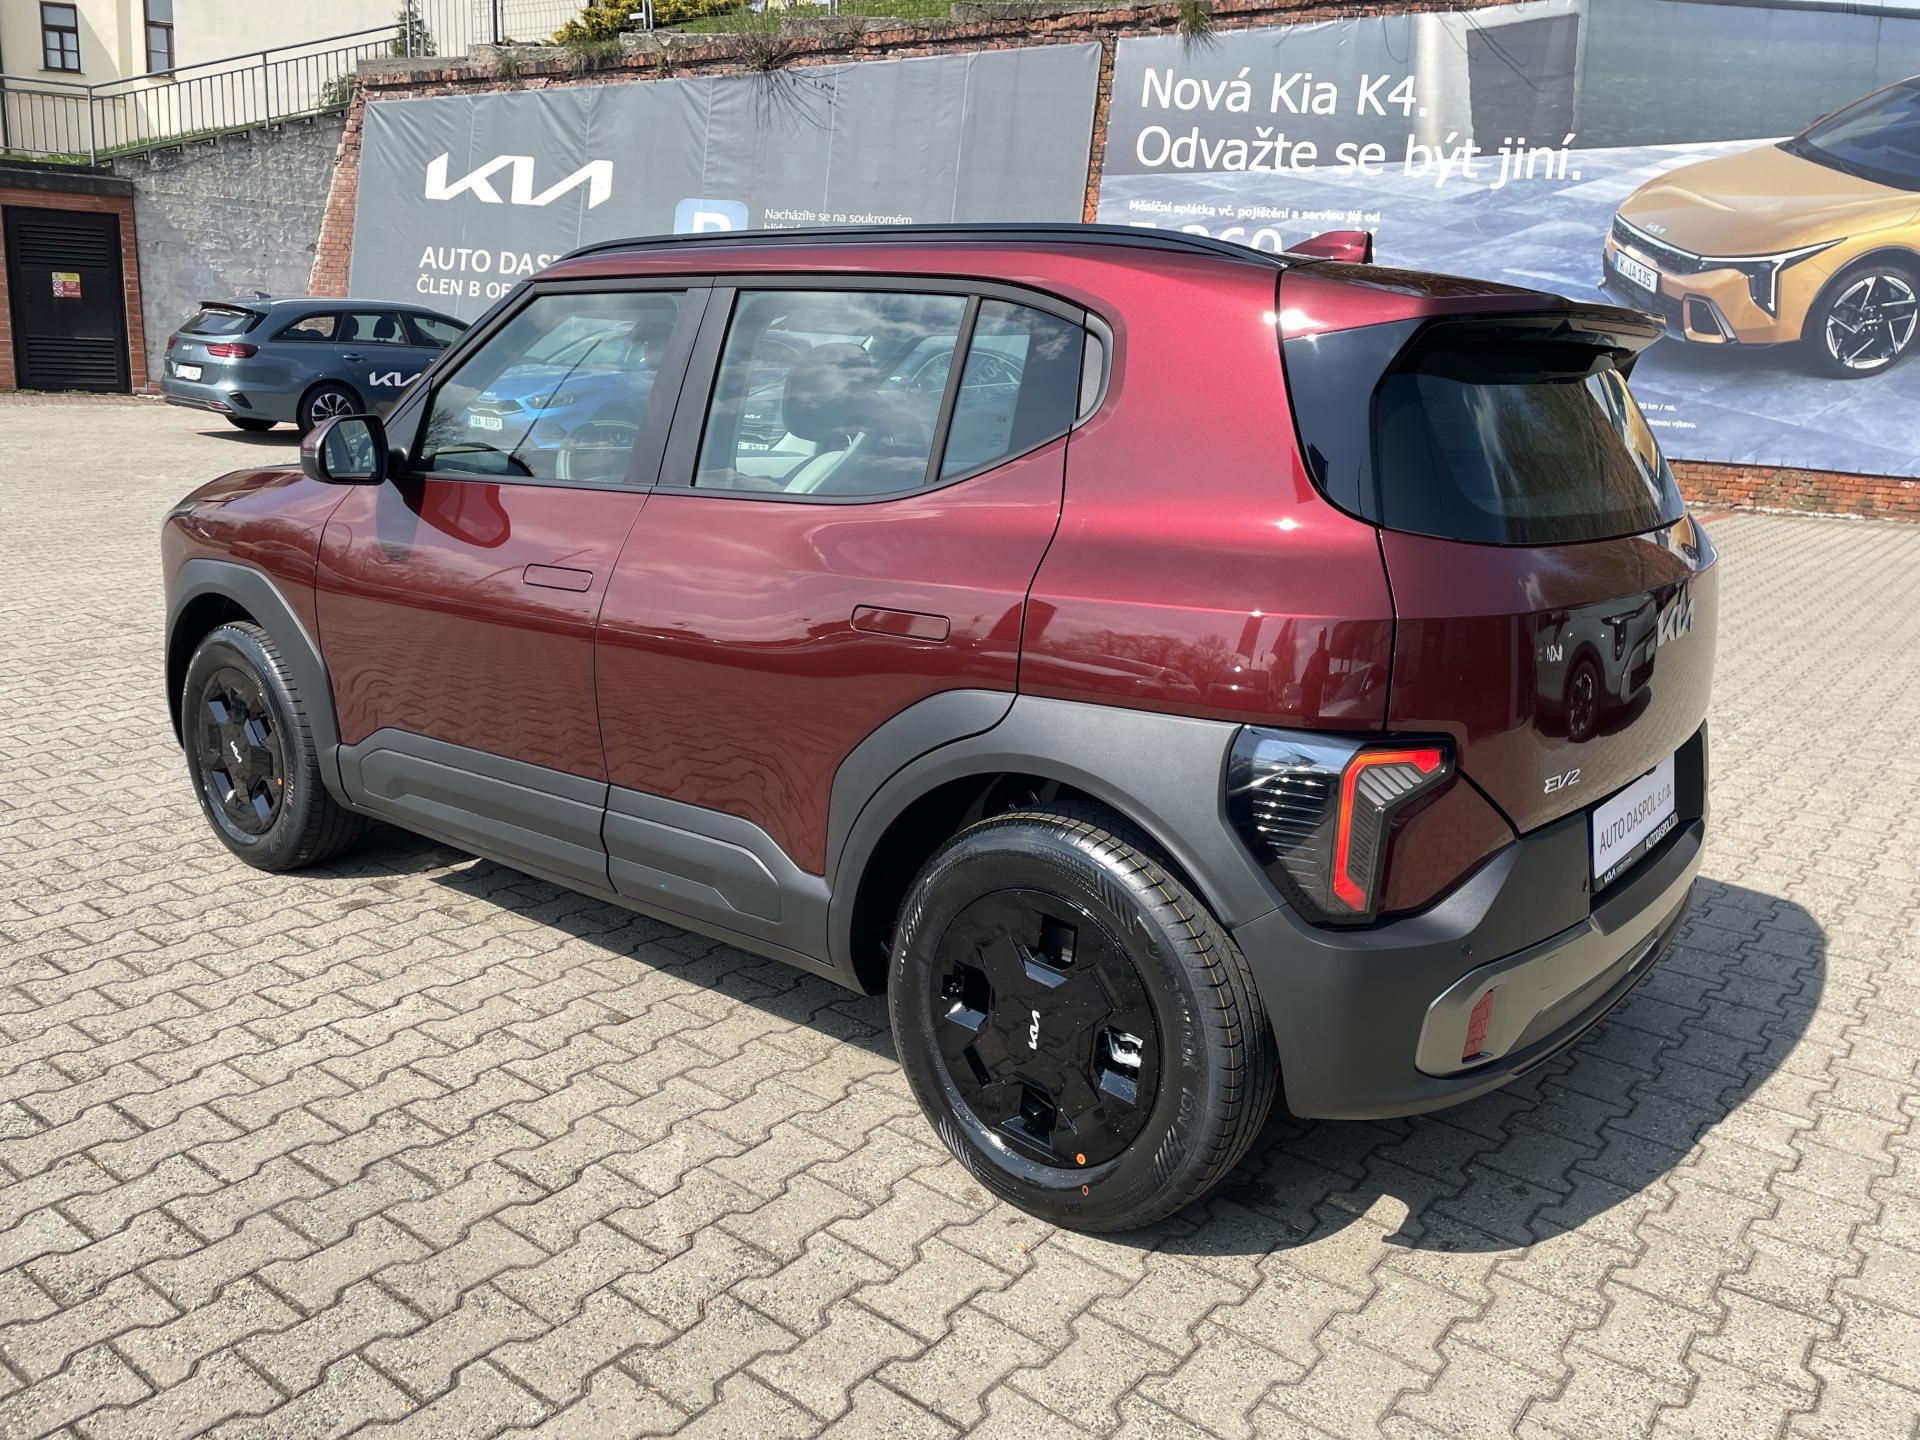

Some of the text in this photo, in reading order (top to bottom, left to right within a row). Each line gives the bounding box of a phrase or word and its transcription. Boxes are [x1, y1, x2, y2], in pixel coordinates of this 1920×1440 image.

[1140, 66, 1428, 118] Nová Kia K4.
[1136, 125, 1582, 190] Odvažte se být jiní.
[424, 151, 614, 210] KIA
[764, 208, 913, 225] Nacházíte se na soukromém
[1129, 199, 1173, 213] Měsíční
[1173, 203, 1216, 216] splátka
[1218, 205, 1235, 217] vč.
[1237, 206, 1290, 220] pojištění
[1291, 211, 1299, 219] a
[1365, 212, 1381, 223] od
[418, 246, 492, 273] AUTO
[416, 273, 463, 296] ČLEN
[468, 280, 480, 297] B
[1543, 767, 1582, 795] EV2
[1600, 816, 1626, 857] AUTO
[1627, 791, 1658, 834] DASPOL
